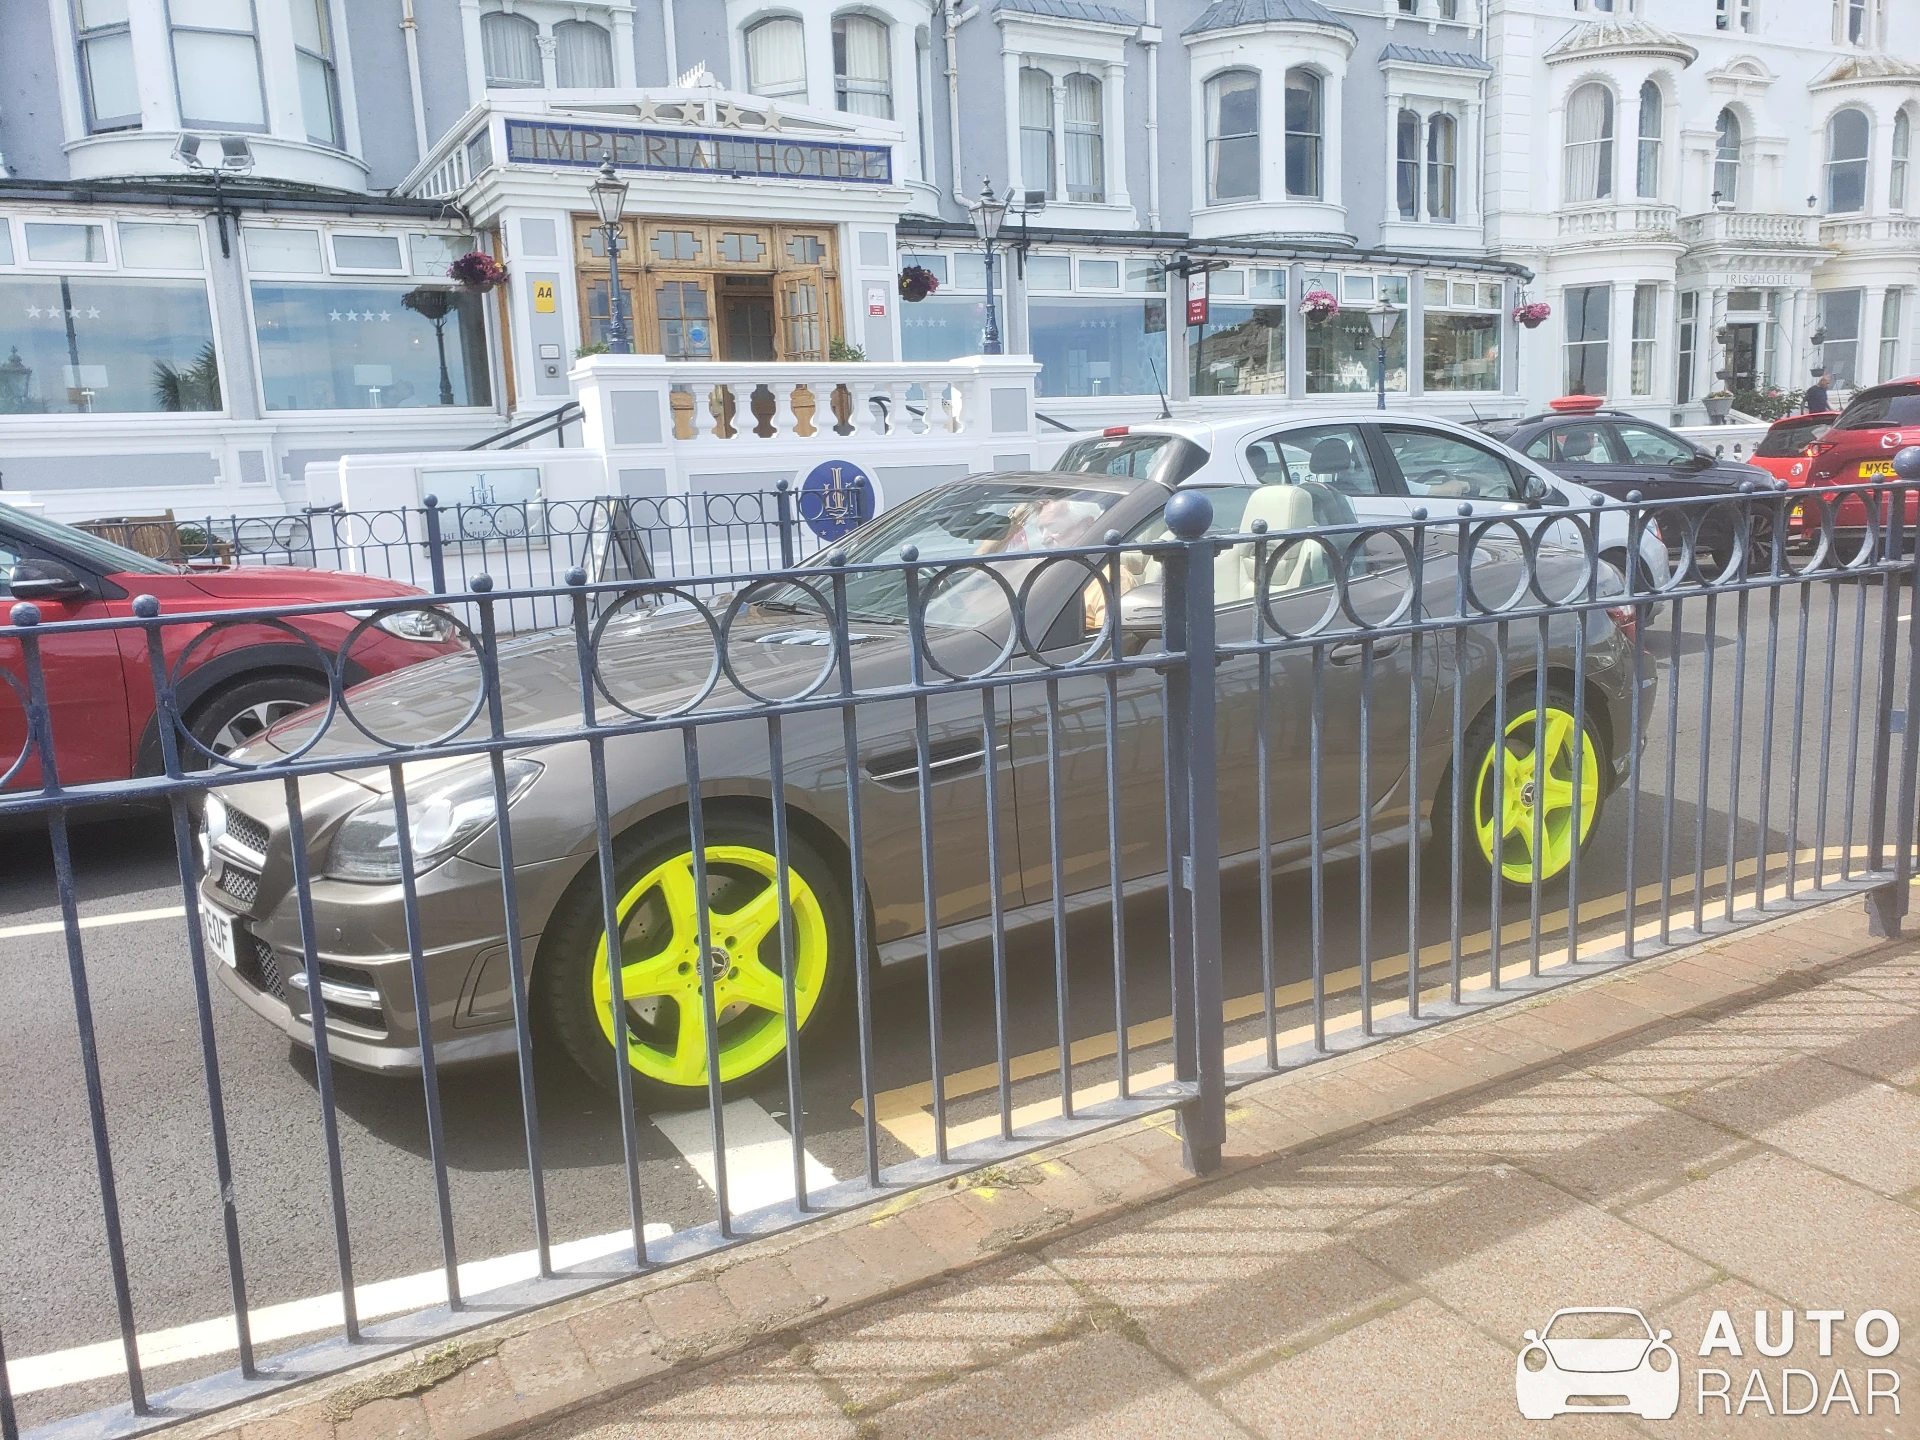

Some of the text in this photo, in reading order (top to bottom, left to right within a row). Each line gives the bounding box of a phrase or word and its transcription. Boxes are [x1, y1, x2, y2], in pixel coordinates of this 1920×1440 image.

[531, 128, 882, 179] IMPERIAL HOTEL
[1726, 274, 1794, 285] IRIS HOTEL
[537, 287, 553, 298] AA
